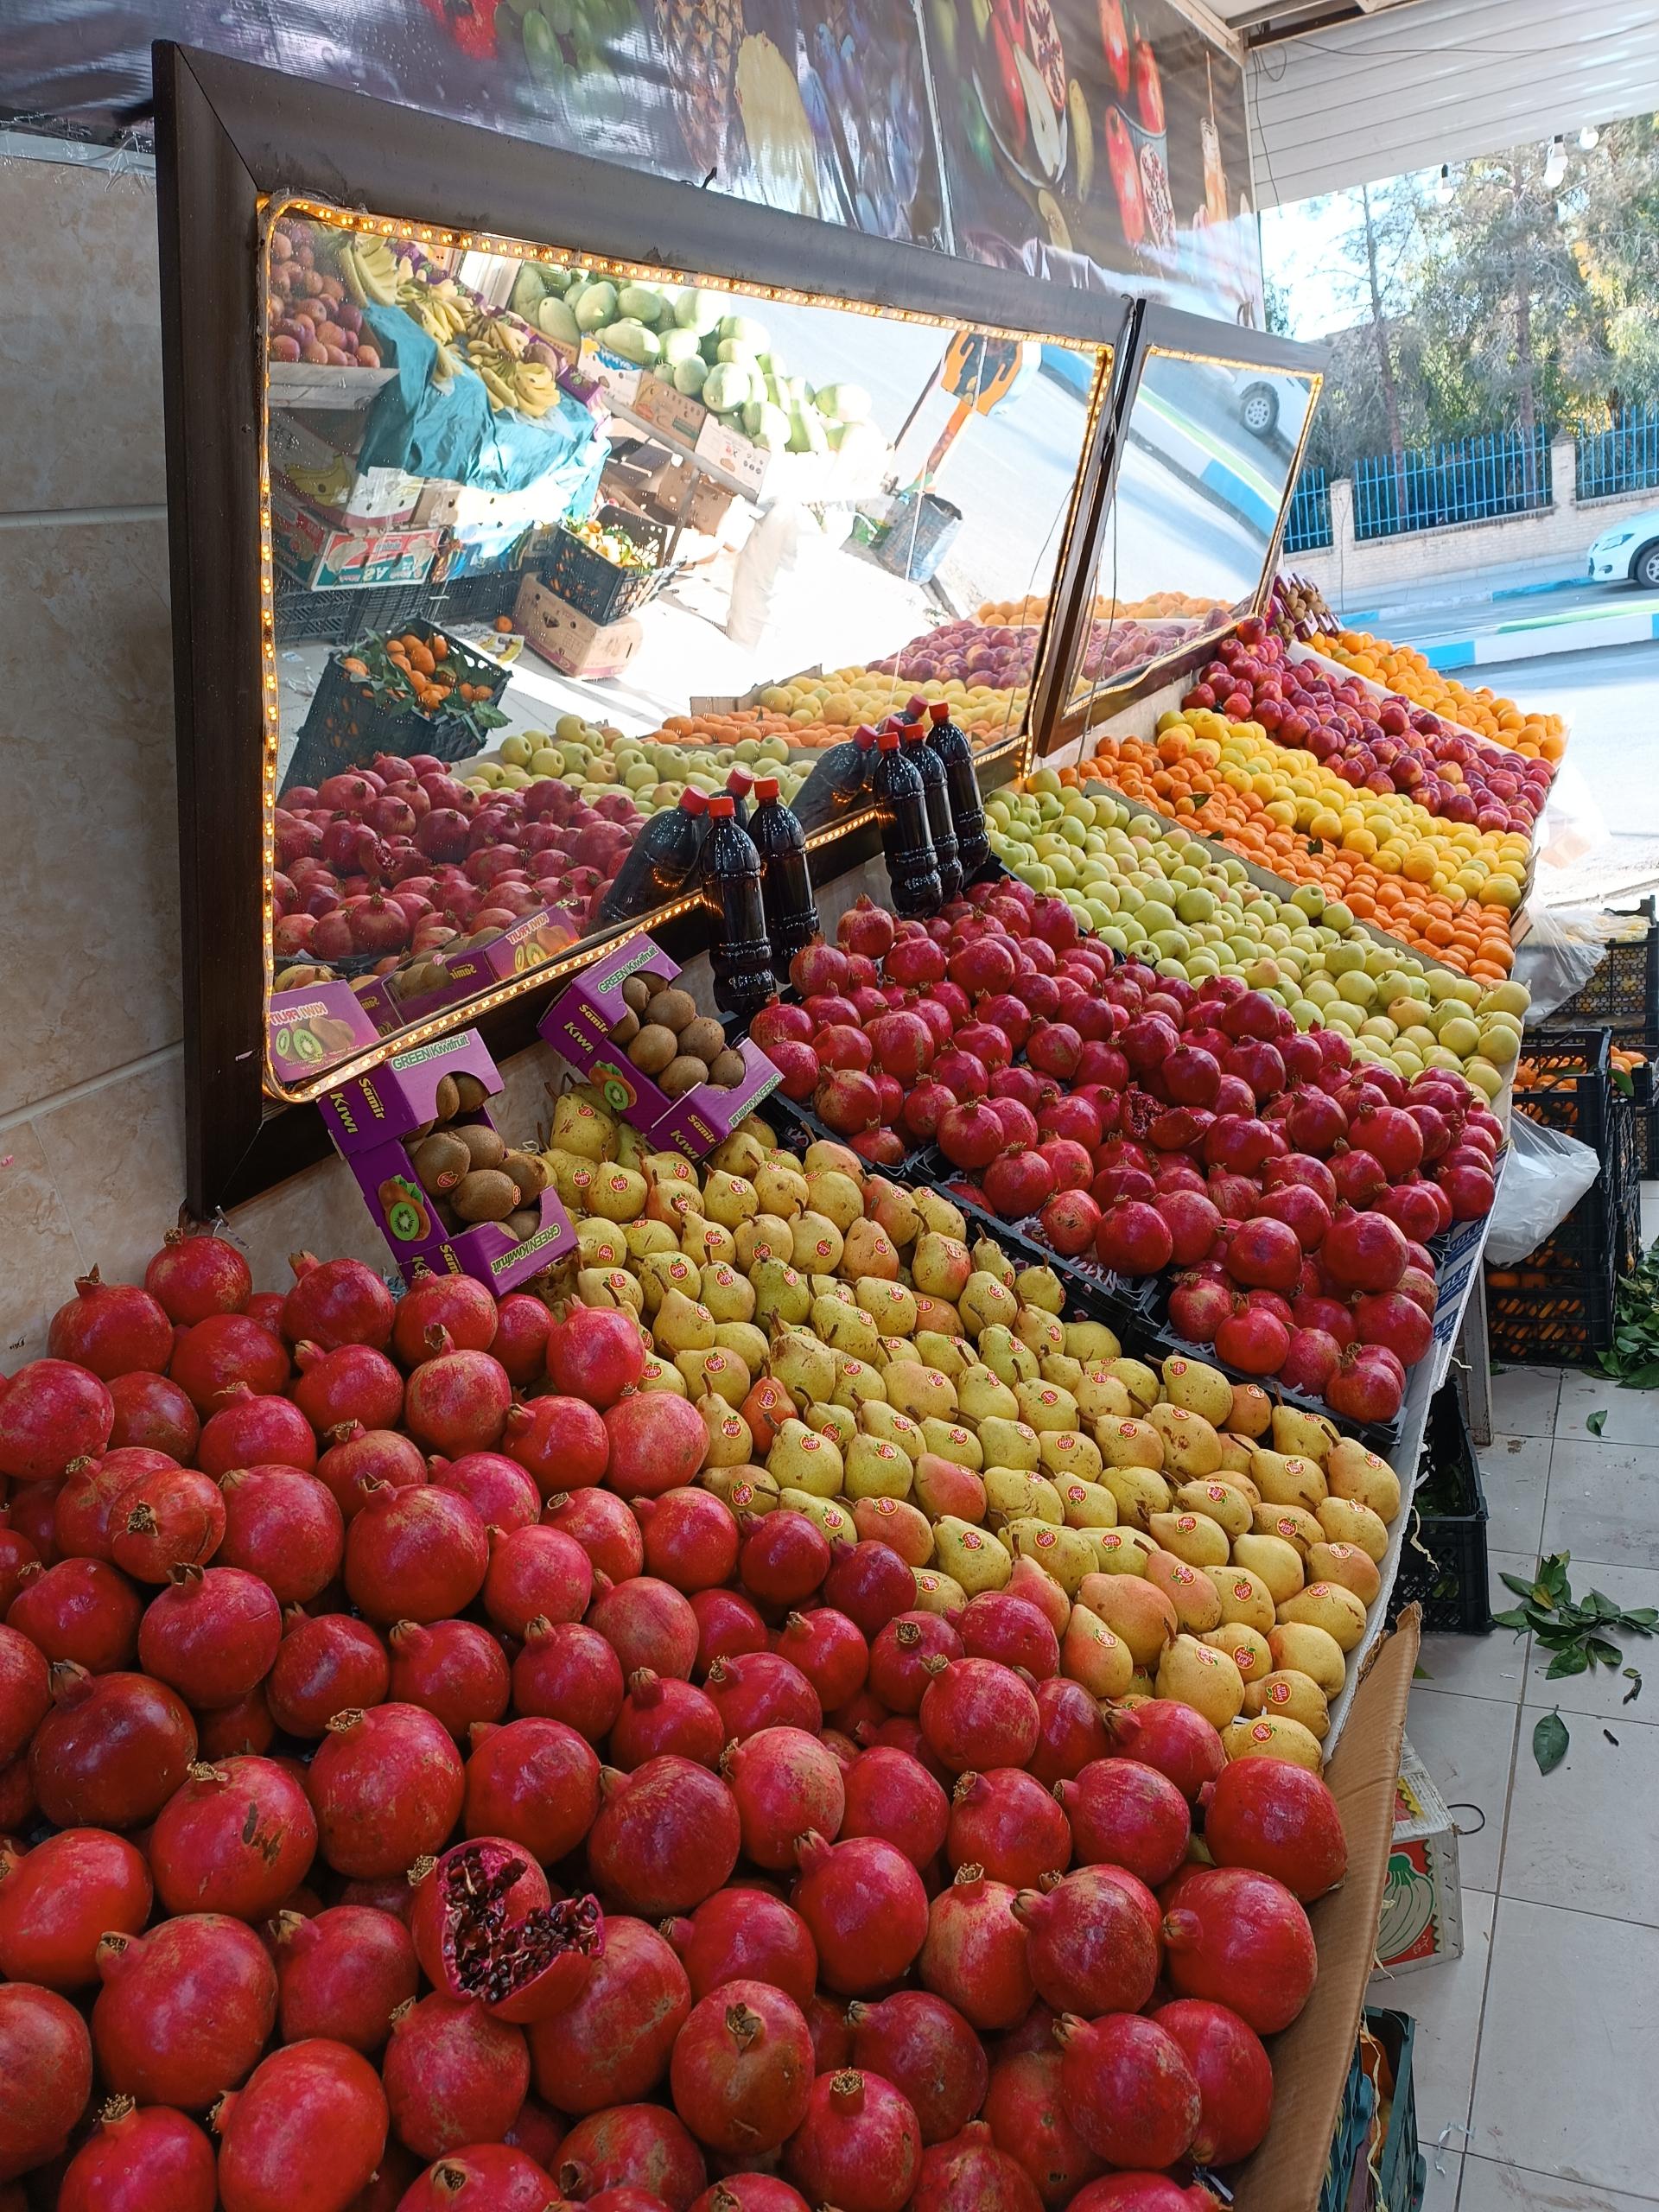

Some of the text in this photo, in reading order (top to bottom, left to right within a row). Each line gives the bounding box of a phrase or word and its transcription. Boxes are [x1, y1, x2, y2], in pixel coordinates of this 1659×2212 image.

[598, 945, 658, 994] GREEN Kiwifruit
[579, 1004, 609, 1033] Samir
[391, 1034, 470, 1071] GREEN Kiwifruit
[359, 1077, 385, 1119] Samir
[758, 1073, 781, 1101] GREEN
[687, 1115, 716, 1144] Samir
[439, 1244, 462, 1274] Sam
[491, 1223, 562, 1276] GREEN Kiwifruit
